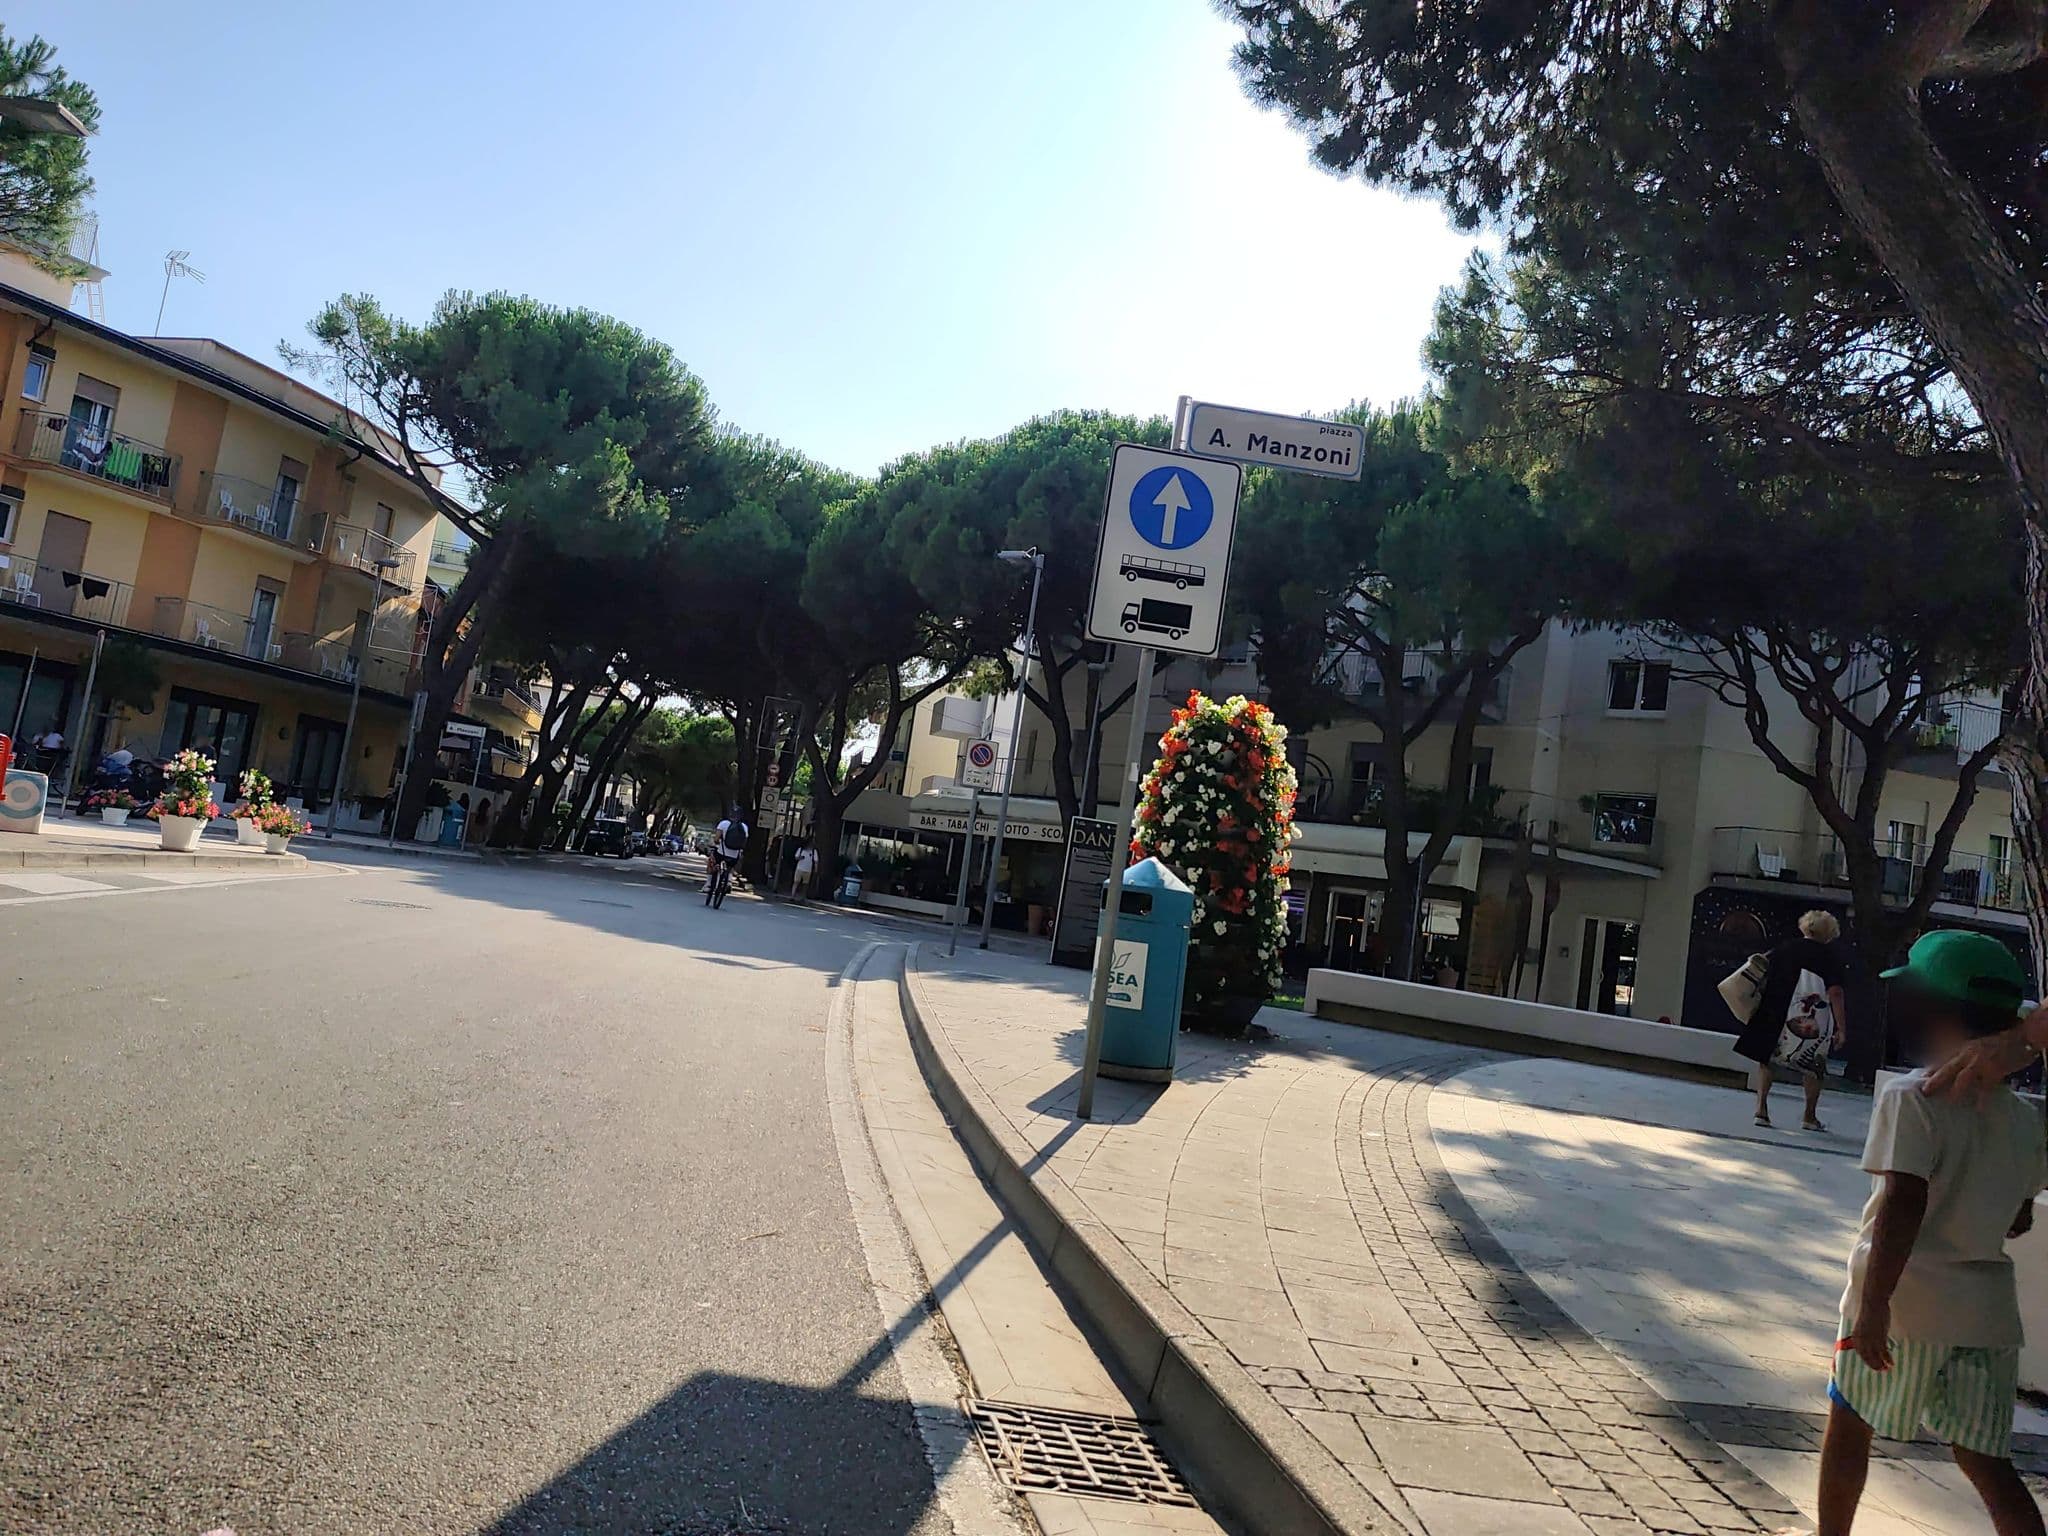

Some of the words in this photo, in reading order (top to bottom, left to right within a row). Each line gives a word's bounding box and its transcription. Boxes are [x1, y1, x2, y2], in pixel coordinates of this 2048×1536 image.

[1319, 426, 1353, 438] piazza
[1209, 428, 1231, 448] A.
[1247, 433, 1352, 466] Manzoni
[920, 815, 937, 827] BAR
[947, 818, 990, 833] TABACHI
[1004, 824, 1030, 836] OTTO
[1040, 827, 1063, 839] SCO
[1073, 829, 1117, 848] DAN
[1107, 970, 1139, 988] SEA
